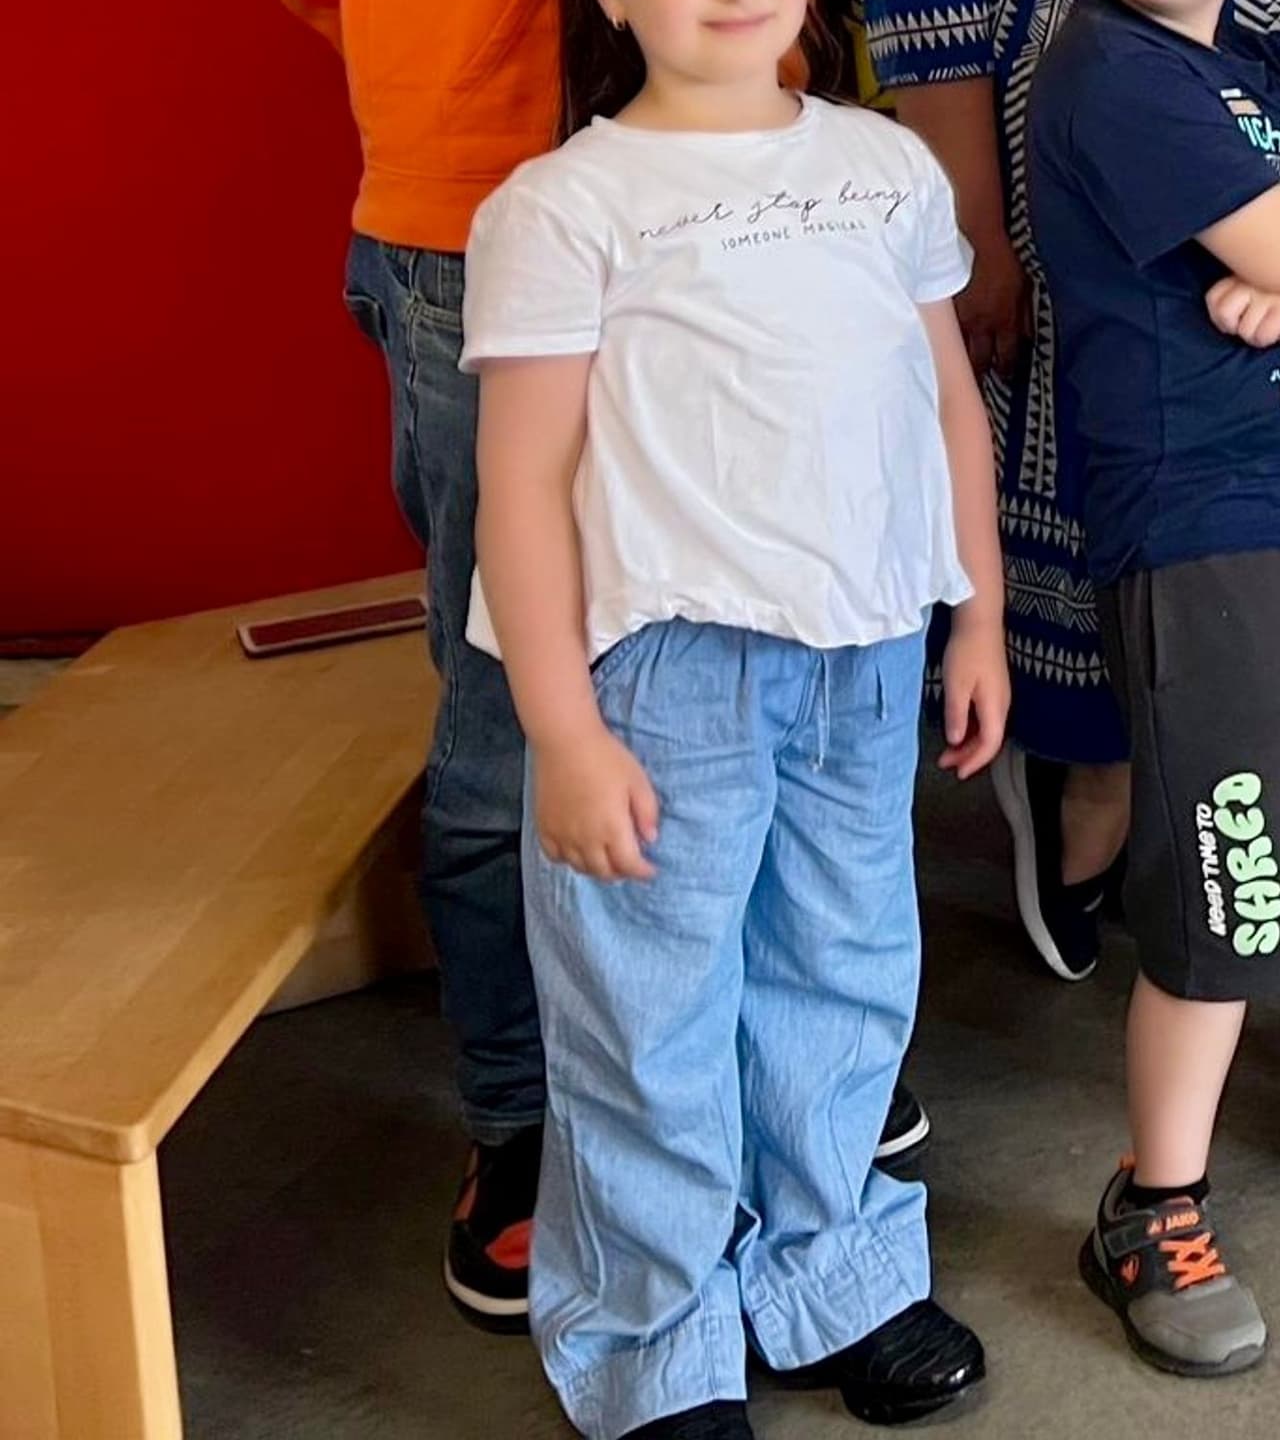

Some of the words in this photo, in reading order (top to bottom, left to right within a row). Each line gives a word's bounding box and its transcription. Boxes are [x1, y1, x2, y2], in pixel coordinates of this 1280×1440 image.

[750, 188, 822, 225] stop
[837, 178, 912, 226] being
[719, 226, 790, 252] SOMEONE
[802, 220, 868, 237] MAGICAL
